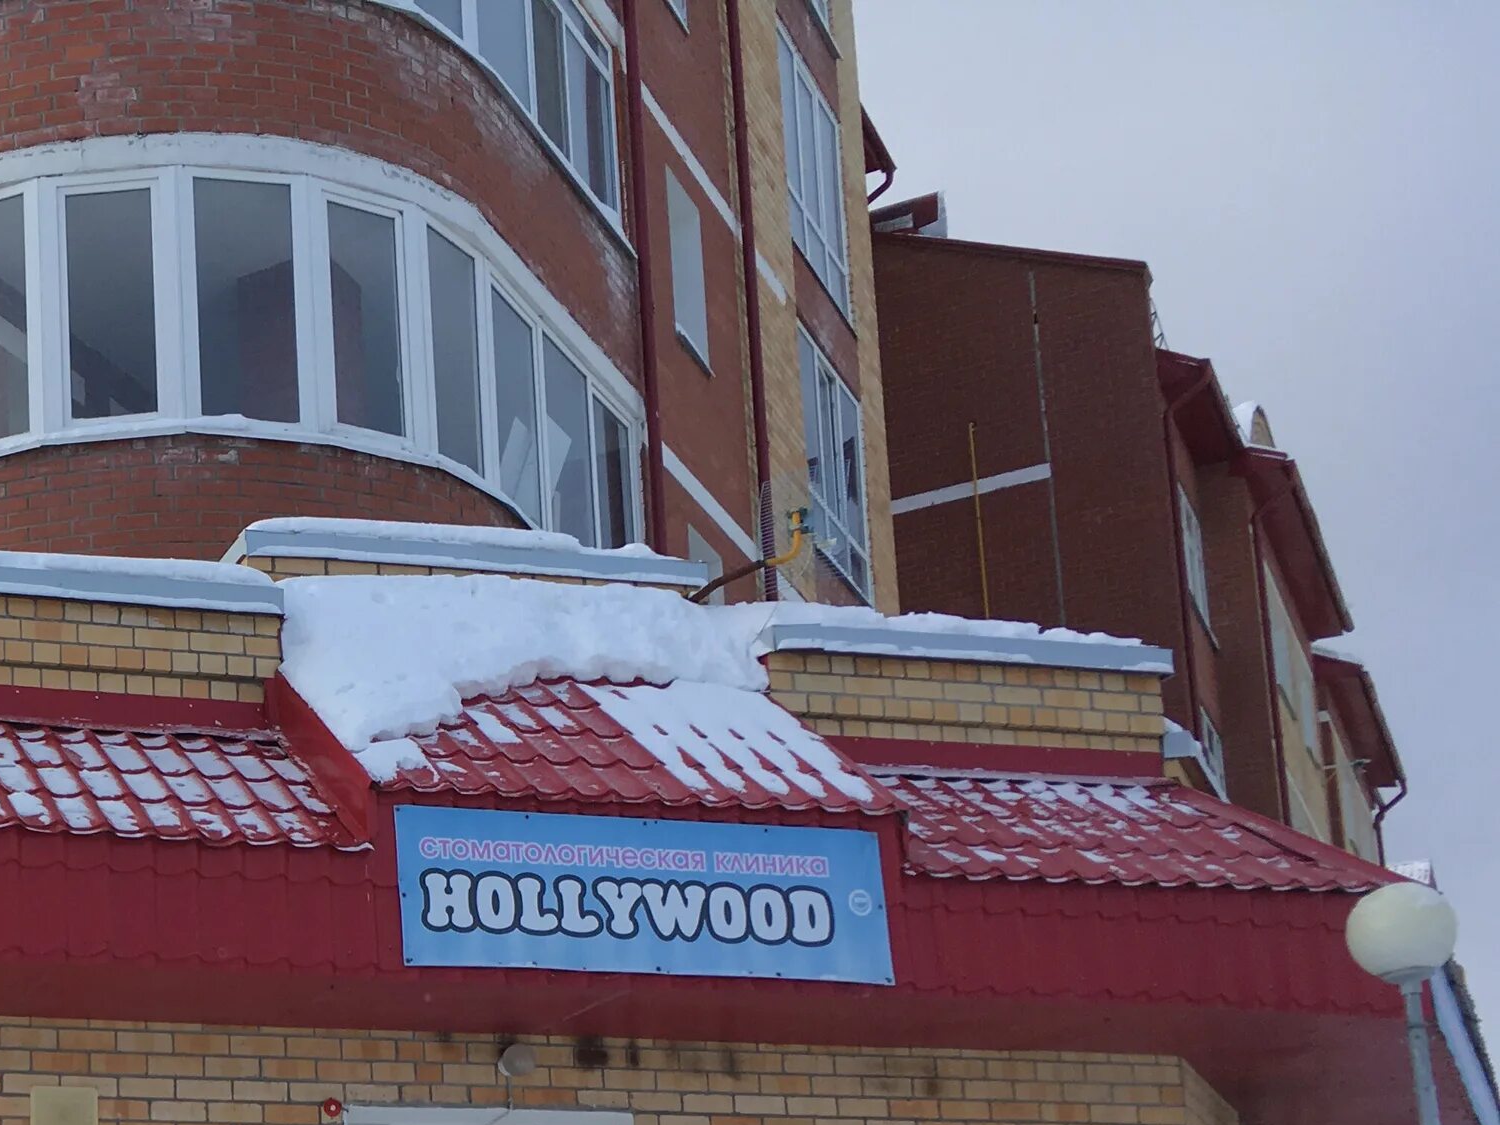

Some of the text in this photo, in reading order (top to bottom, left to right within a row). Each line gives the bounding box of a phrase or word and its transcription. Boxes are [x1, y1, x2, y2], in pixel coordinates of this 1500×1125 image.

[419, 835, 830, 878] стоматологическая клиника
[419, 868, 835, 948] HOLLYWOOD
